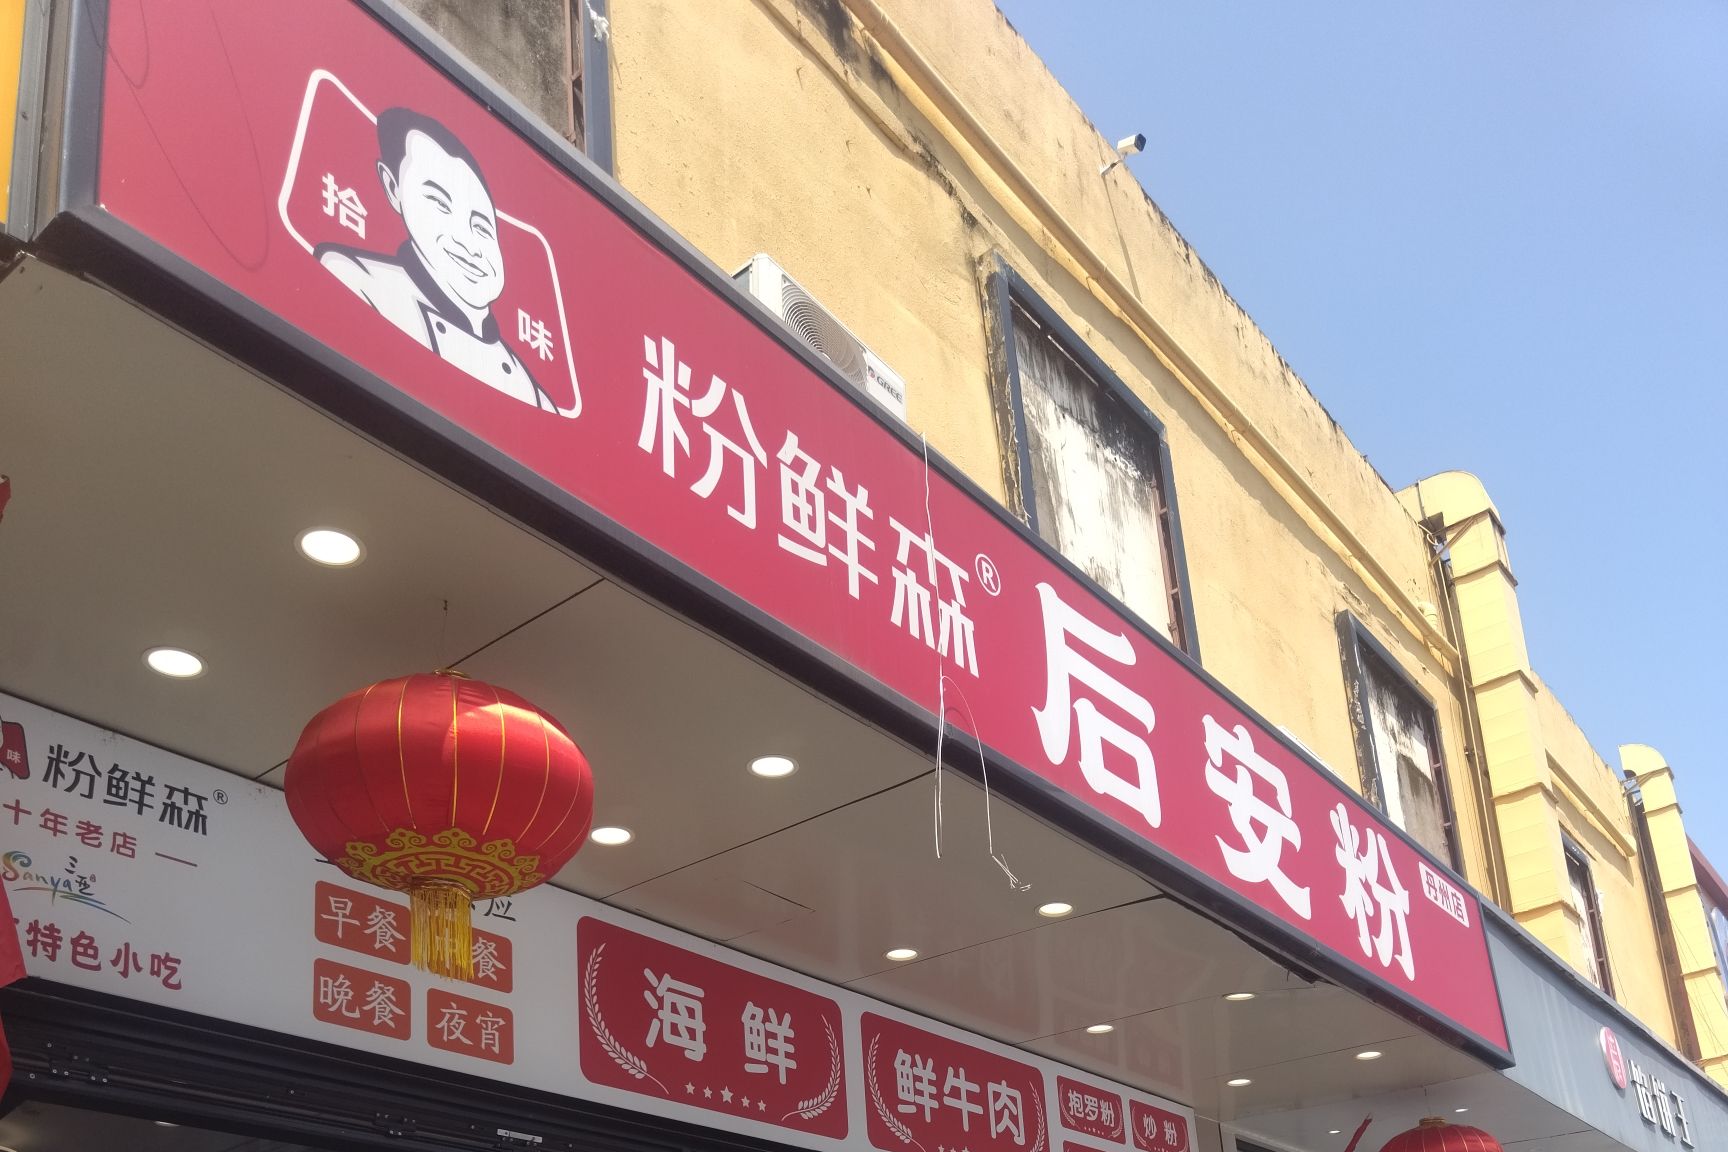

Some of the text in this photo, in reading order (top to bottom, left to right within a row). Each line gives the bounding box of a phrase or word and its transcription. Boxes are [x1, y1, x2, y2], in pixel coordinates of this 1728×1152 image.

[322, 174, 368, 238] 拾
[517, 310, 555, 362] 味
[877, 376, 903, 404] GREE
[7, 749, 21, 764] 味
[1031, 582, 1415, 981] 后安粉
[1, 851, 72, 905] Sanya
[1425, 869, 1465, 922] 丹州店
[320, 895, 406, 953] 早餐
[13, 917, 183, 991] 特色小吃
[319, 974, 406, 1029] 晚餐
[434, 1002, 506, 1054] 夜宵
[644, 967, 798, 1085] 海鲜
[893, 1048, 1027, 1146] 鲜牛肉
[1068, 1089, 1115, 1127] 抱罗粉
[1143, 1113, 1177, 1146] 炒粉
